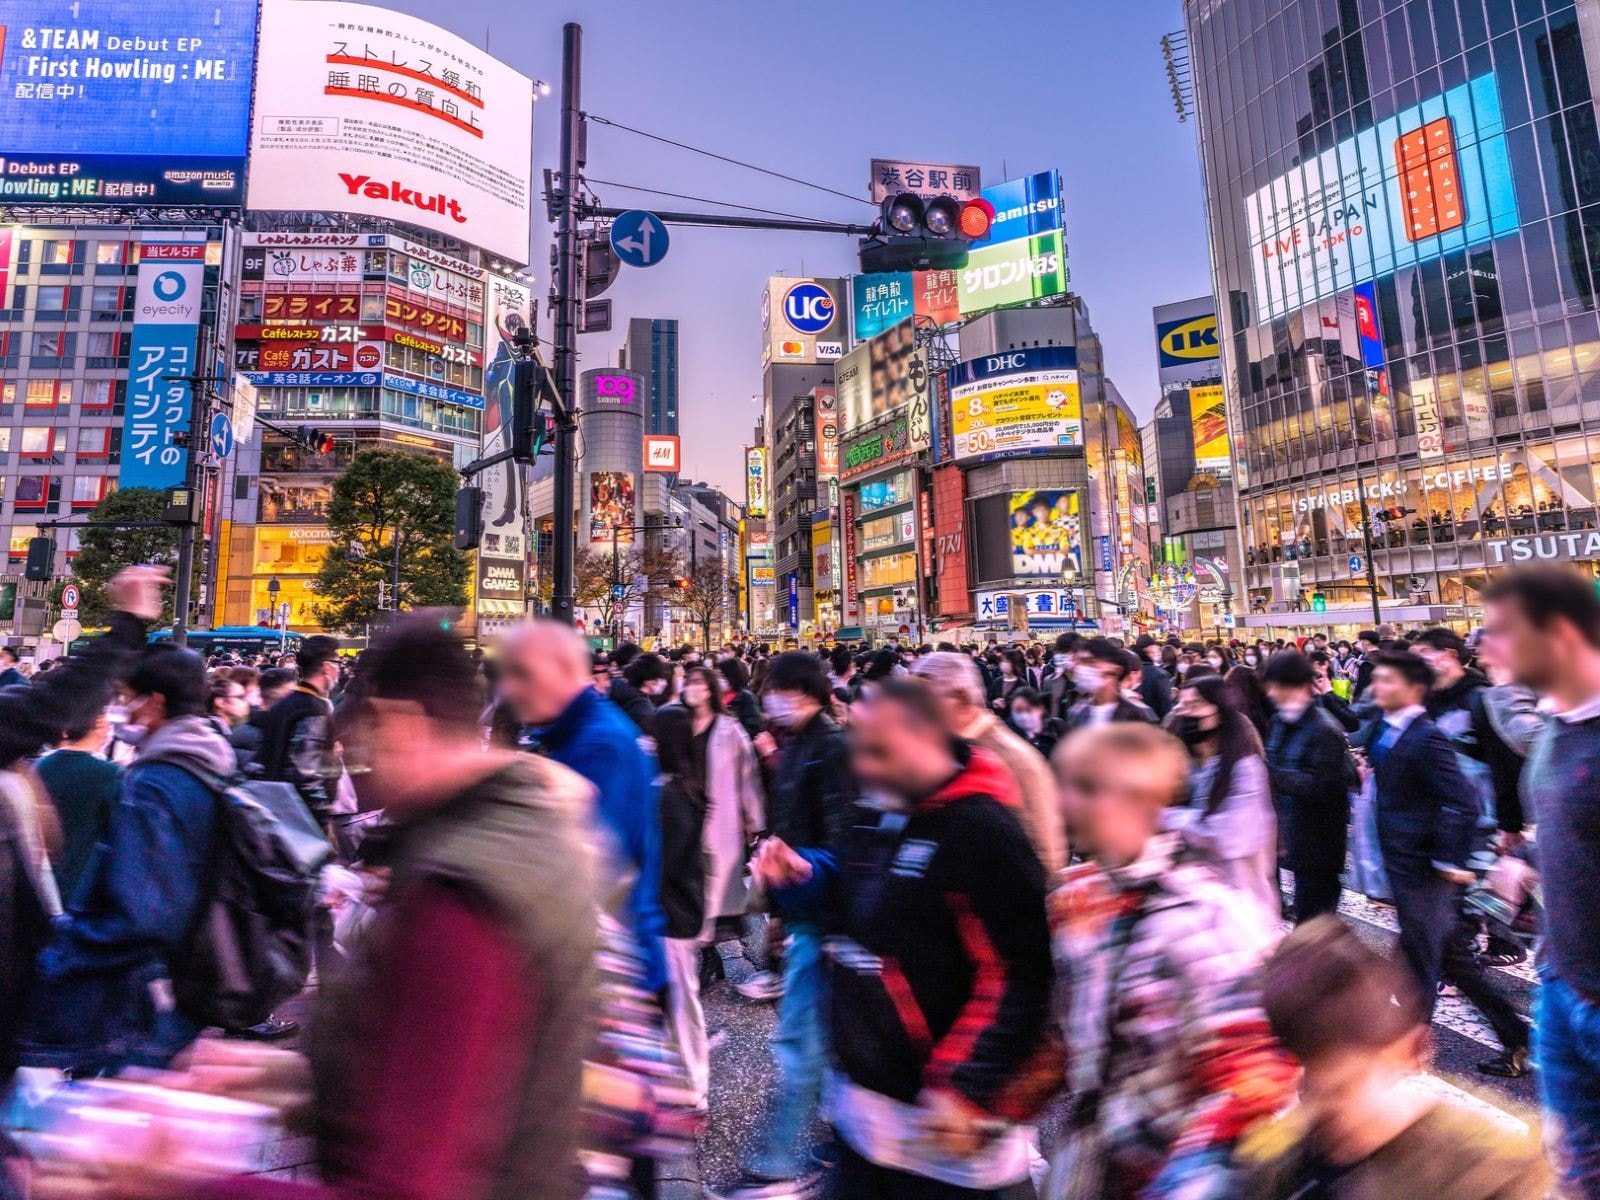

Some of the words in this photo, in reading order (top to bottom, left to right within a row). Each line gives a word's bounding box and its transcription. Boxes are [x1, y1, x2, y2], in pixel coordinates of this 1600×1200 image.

[21, 28, 99, 50] &TEAM
[107, 36, 169, 51] Debut
[177, 38, 202, 51] EP
[85, 57, 176, 84] Howling
[331, 41, 482, 102] ストレス緩和
[327, 70, 482, 132] 睡眠の質向上
[9, 162, 54, 174] Debut
[59, 163, 79, 174] EP
[164, 171, 202, 182] amazon
[203, 170, 235, 180] music
[881, 166, 972, 191] 渋谷駅前
[338, 173, 468, 223] Yakult
[1264, 228, 1302, 259] LIVE
[1308, 193, 1377, 237] JAPAN
[257, 233, 359, 246] しゃぶしゃぶバイキング
[147, 245, 199, 260] 当ビル5F
[245, 258, 263, 270] 9F
[300, 255, 357, 272] しゃぶ葉
[403, 241, 485, 278] しゃぶしゃぶバイキング
[436, 272, 482, 303] しゃぶ葉
[865, 280, 902, 303] 龍角散
[142, 305, 193, 320] eyecity
[265, 297, 357, 315] プライス
[387, 299, 463, 336] コンタクト
[788, 296, 832, 320] UC
[322, 325, 367, 342] ガスト
[1171, 326, 1218, 352] IK
[237, 350, 259, 364] 7F
[263, 350, 289, 361] Café
[291, 347, 349, 370] ガスト
[442, 344, 478, 366] ガスト
[818, 345, 842, 354] VISA
[987, 353, 1026, 373] DHC
[273, 373, 357, 385] 英会話イーオン
[595, 376, 635, 404] 109
[131, 346, 166, 466] アイシティ
[160, 346, 188, 467] コンタクトの
[417, 383, 485, 407] 英会話イーオン
[908, 352, 931, 447] もんじゃ
[652, 447, 671, 460] H&M
[1297, 480, 1410, 512] STARBUCKS
[1418, 462, 1513, 491] COFFEE
[482, 577, 521, 592] GAMES
[487, 566, 516, 580] DMM
